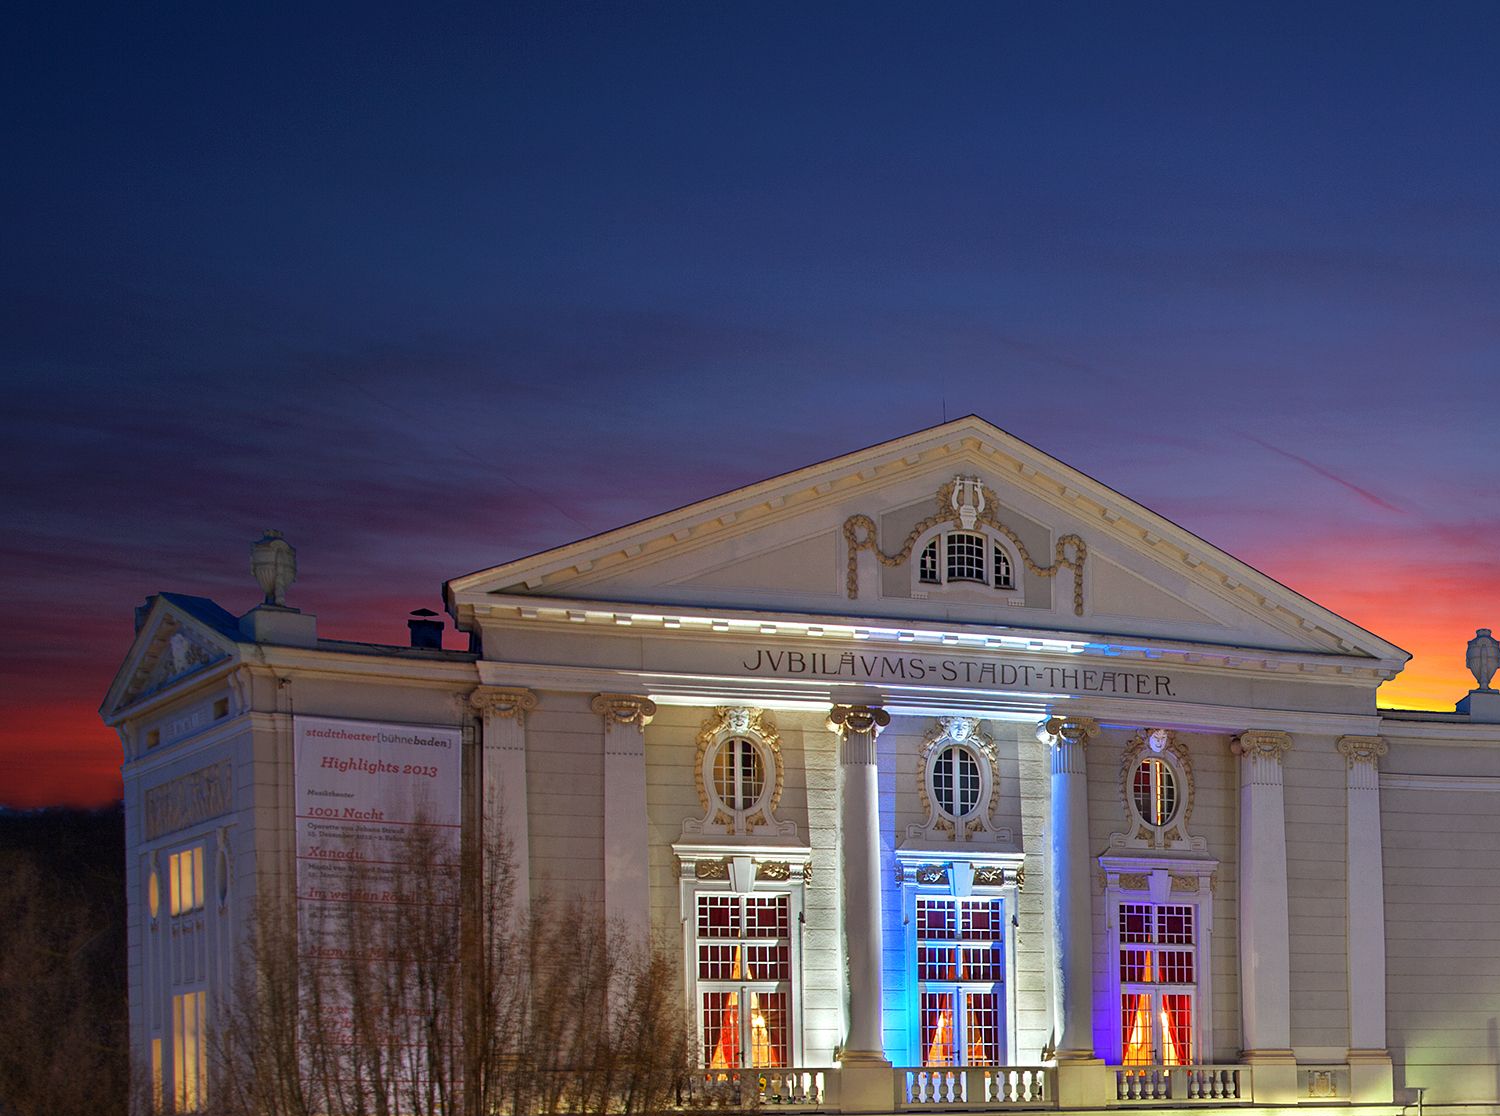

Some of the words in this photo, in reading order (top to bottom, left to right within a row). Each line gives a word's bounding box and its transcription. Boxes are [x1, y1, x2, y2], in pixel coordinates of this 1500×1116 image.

[320, 756, 400, 774] Highlights
[402, 764, 438, 778] 2013
[307, 789, 355, 798] Musiktheater
[307, 807, 338, 817] 1001
[343, 808, 384, 820] Nacht
[307, 846, 364, 860] Xanadu
[329, 888, 378, 901] weßen
